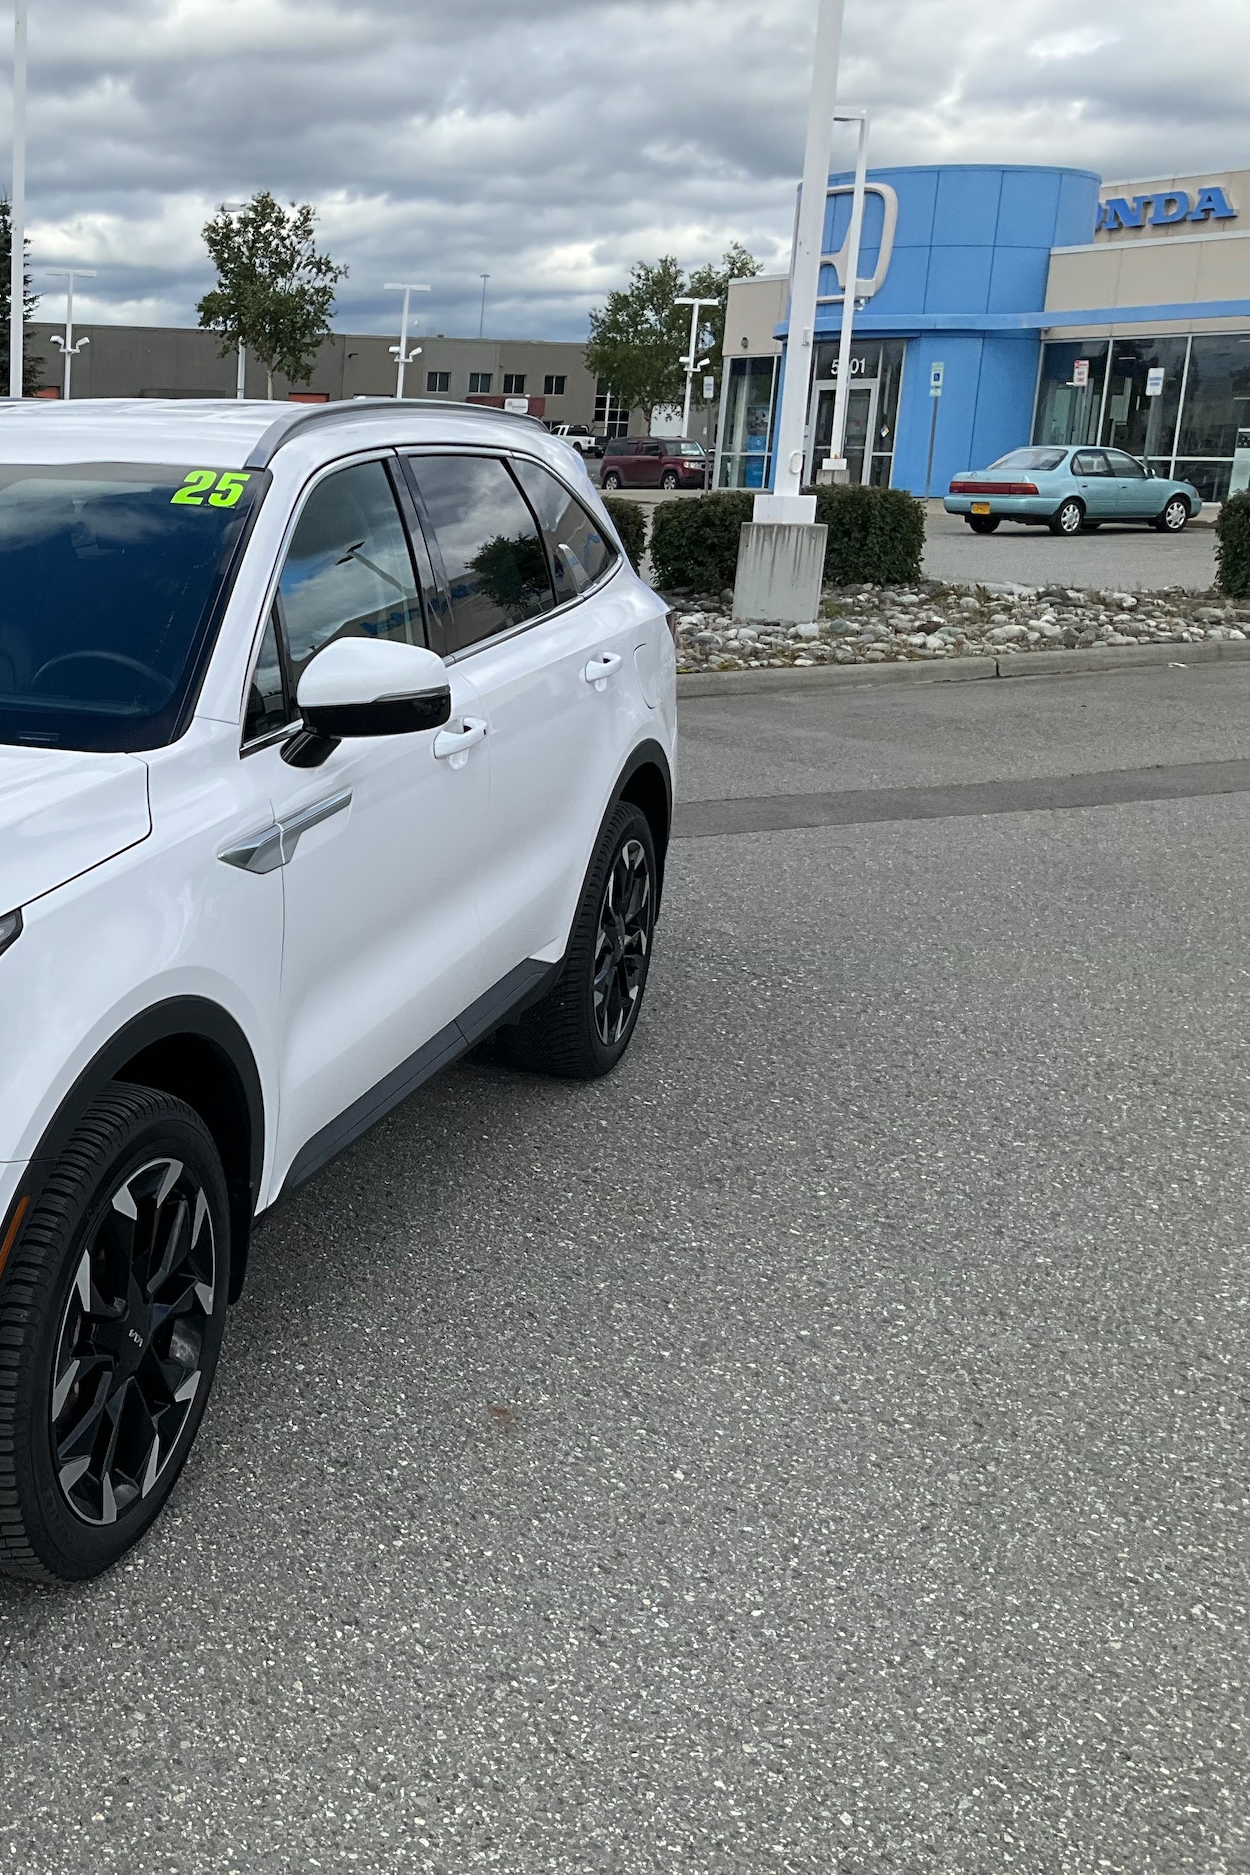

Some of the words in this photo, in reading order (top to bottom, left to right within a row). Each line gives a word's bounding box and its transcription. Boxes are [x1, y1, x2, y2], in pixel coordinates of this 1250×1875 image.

[1096, 187, 1234, 230] NDA
[831, 357, 866, 374] 501
[170, 470, 251, 508] 25
